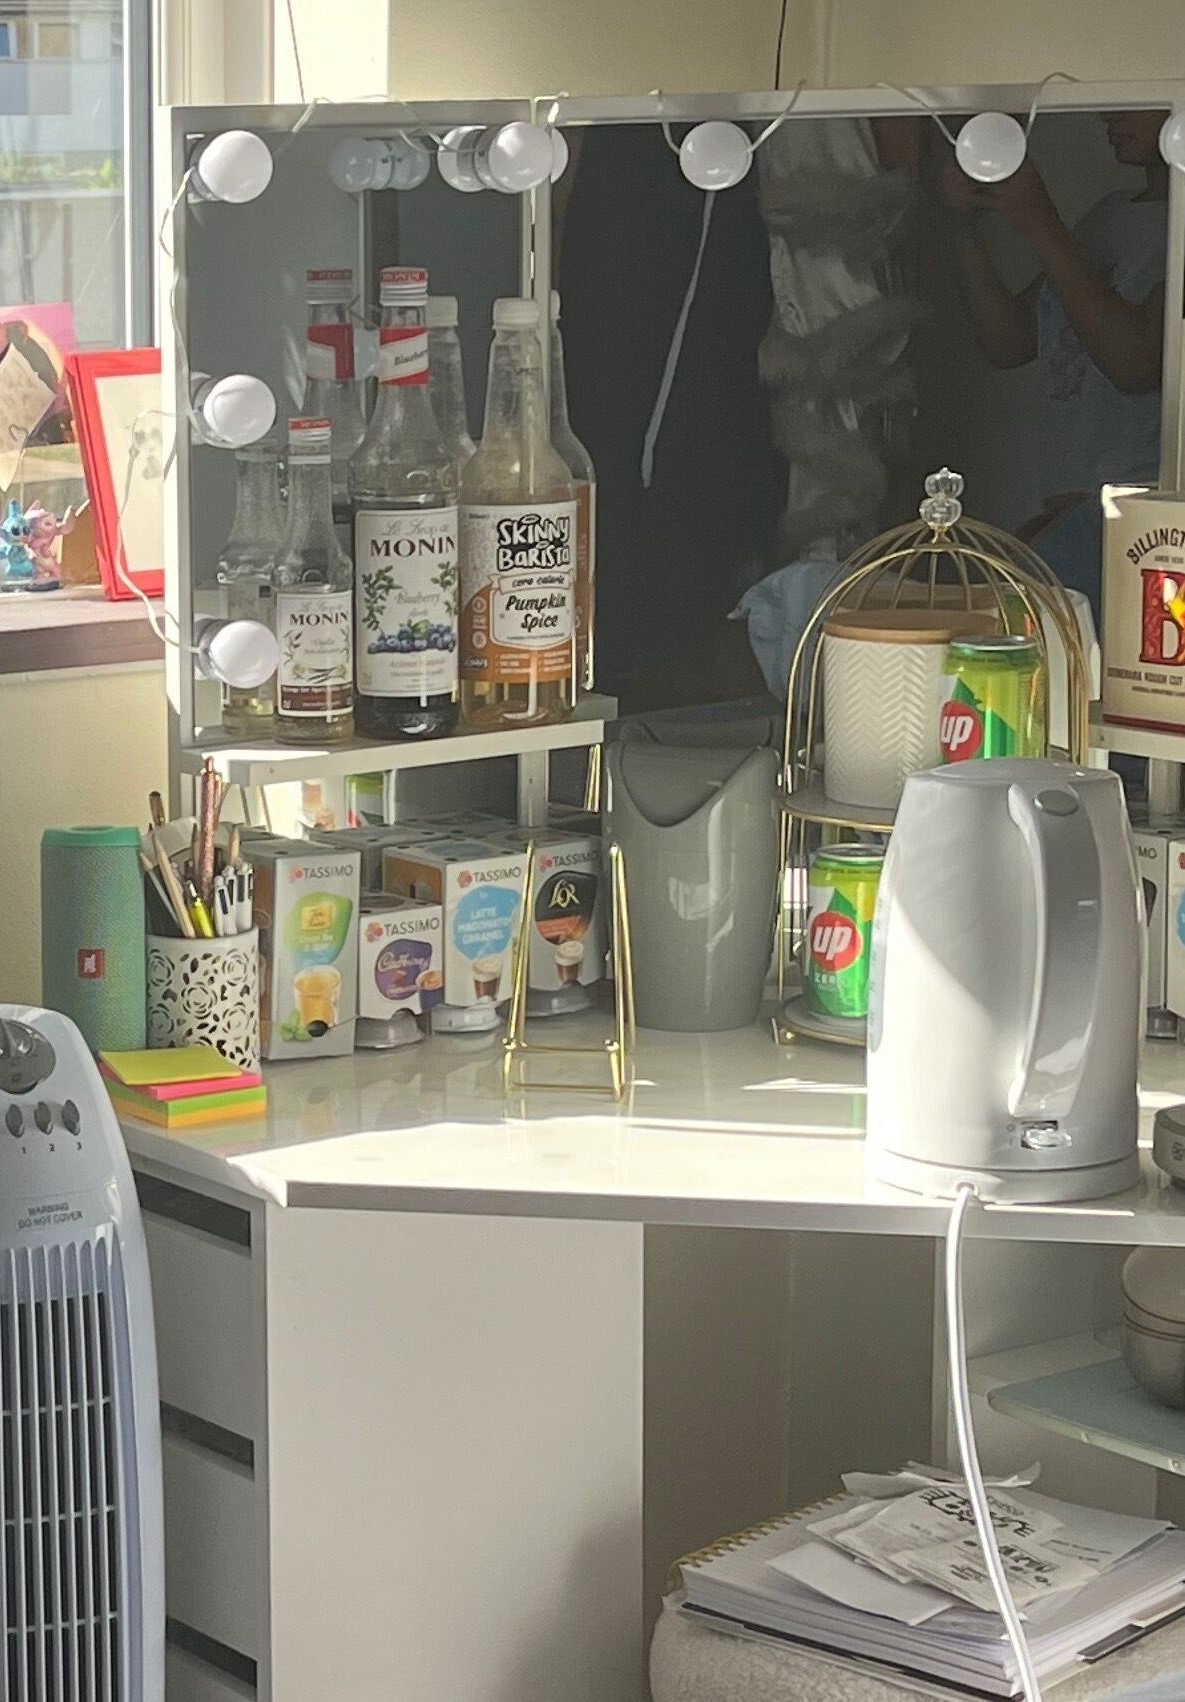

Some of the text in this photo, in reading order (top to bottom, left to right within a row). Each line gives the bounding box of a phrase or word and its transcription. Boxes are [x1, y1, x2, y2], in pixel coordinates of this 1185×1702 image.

[497, 514, 570, 545] SKINNY
[370, 535, 455, 557] MONIN
[506, 593, 566, 613] Pumpkin
[290, 612, 349, 627] MONIN
[521, 613, 558, 632] Spice
[303, 864, 354, 880] TASSIMO
[473, 866, 522, 883] TASSIMO
[384, 917, 440, 936] TASSIMO
[27, 1202, 69, 1216] WARNING
[17, 1210, 83, 1229] DO NOT COVER
